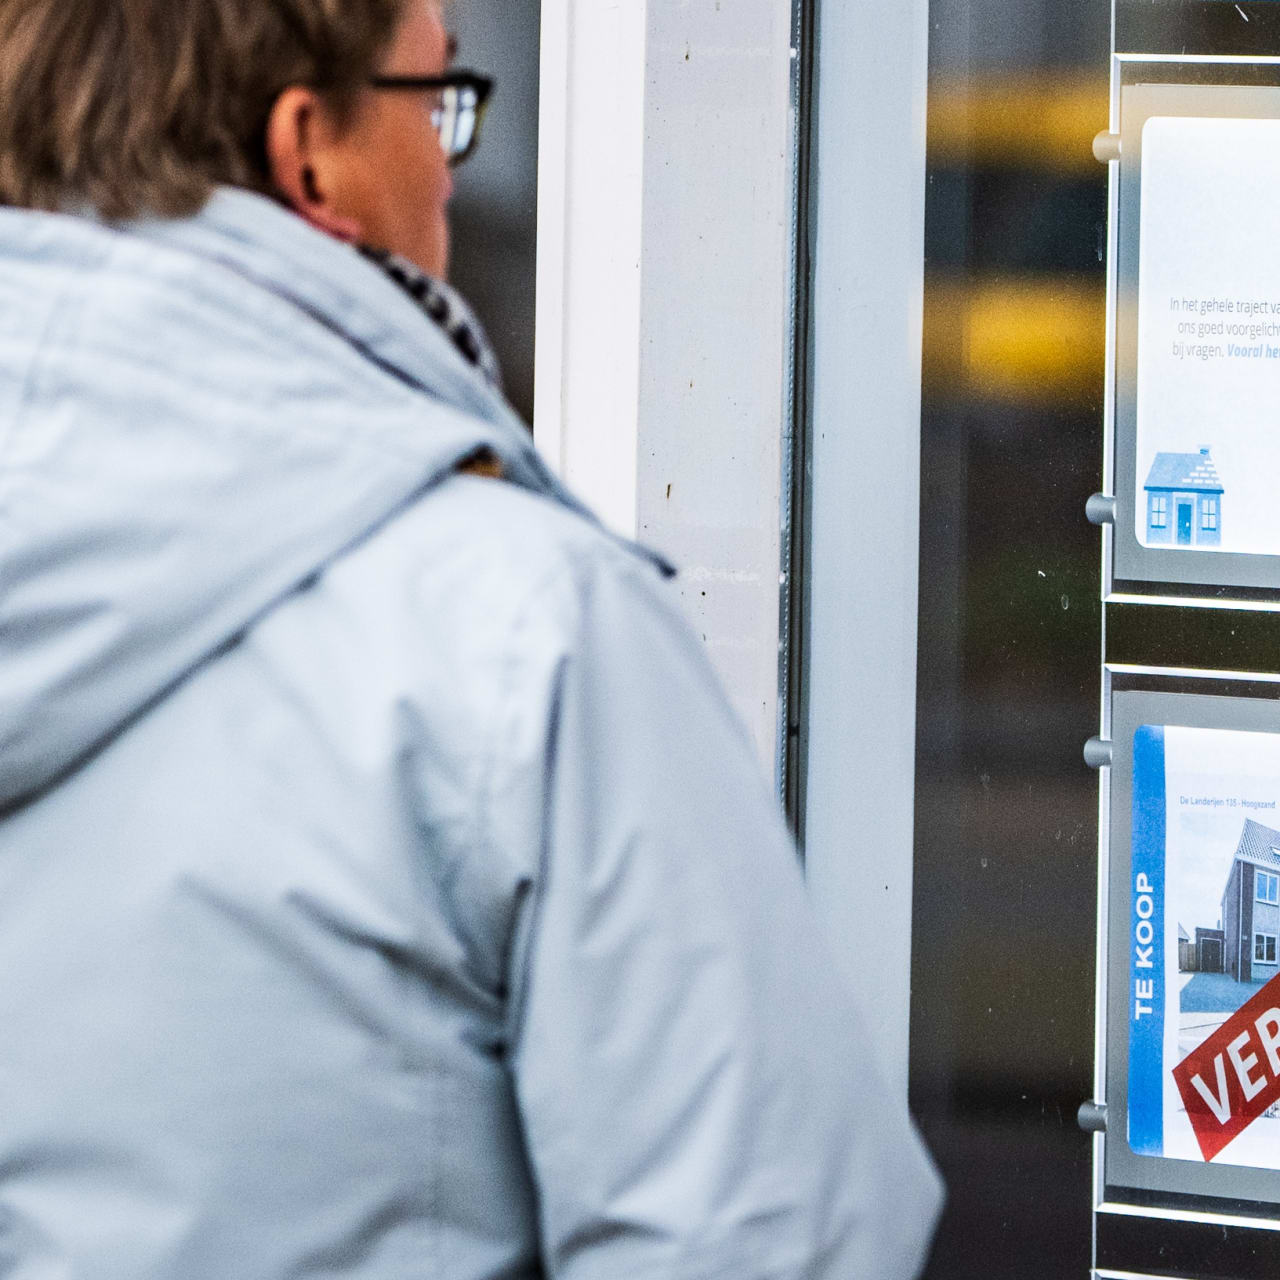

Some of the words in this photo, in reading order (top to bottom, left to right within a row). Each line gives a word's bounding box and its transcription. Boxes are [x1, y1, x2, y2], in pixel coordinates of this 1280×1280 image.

[1170, 296, 1180, 312] In
[1182, 297, 1198, 312] het
[1200, 297, 1234, 316] gehele
[1236, 299, 1269, 317] traject
[1177, 322, 1195, 334] ons
[1198, 321, 1224, 338] goed
[1172, 341, 1184, 359] bij
[1186, 345, 1224, 360] vragen.
[1227, 343, 1263, 358] Vooral
[1241, 800, 1276, 810] Hoogezand
[1135, 871, 1154, 970] KOOP
[1135, 976, 1153, 1021] TE
